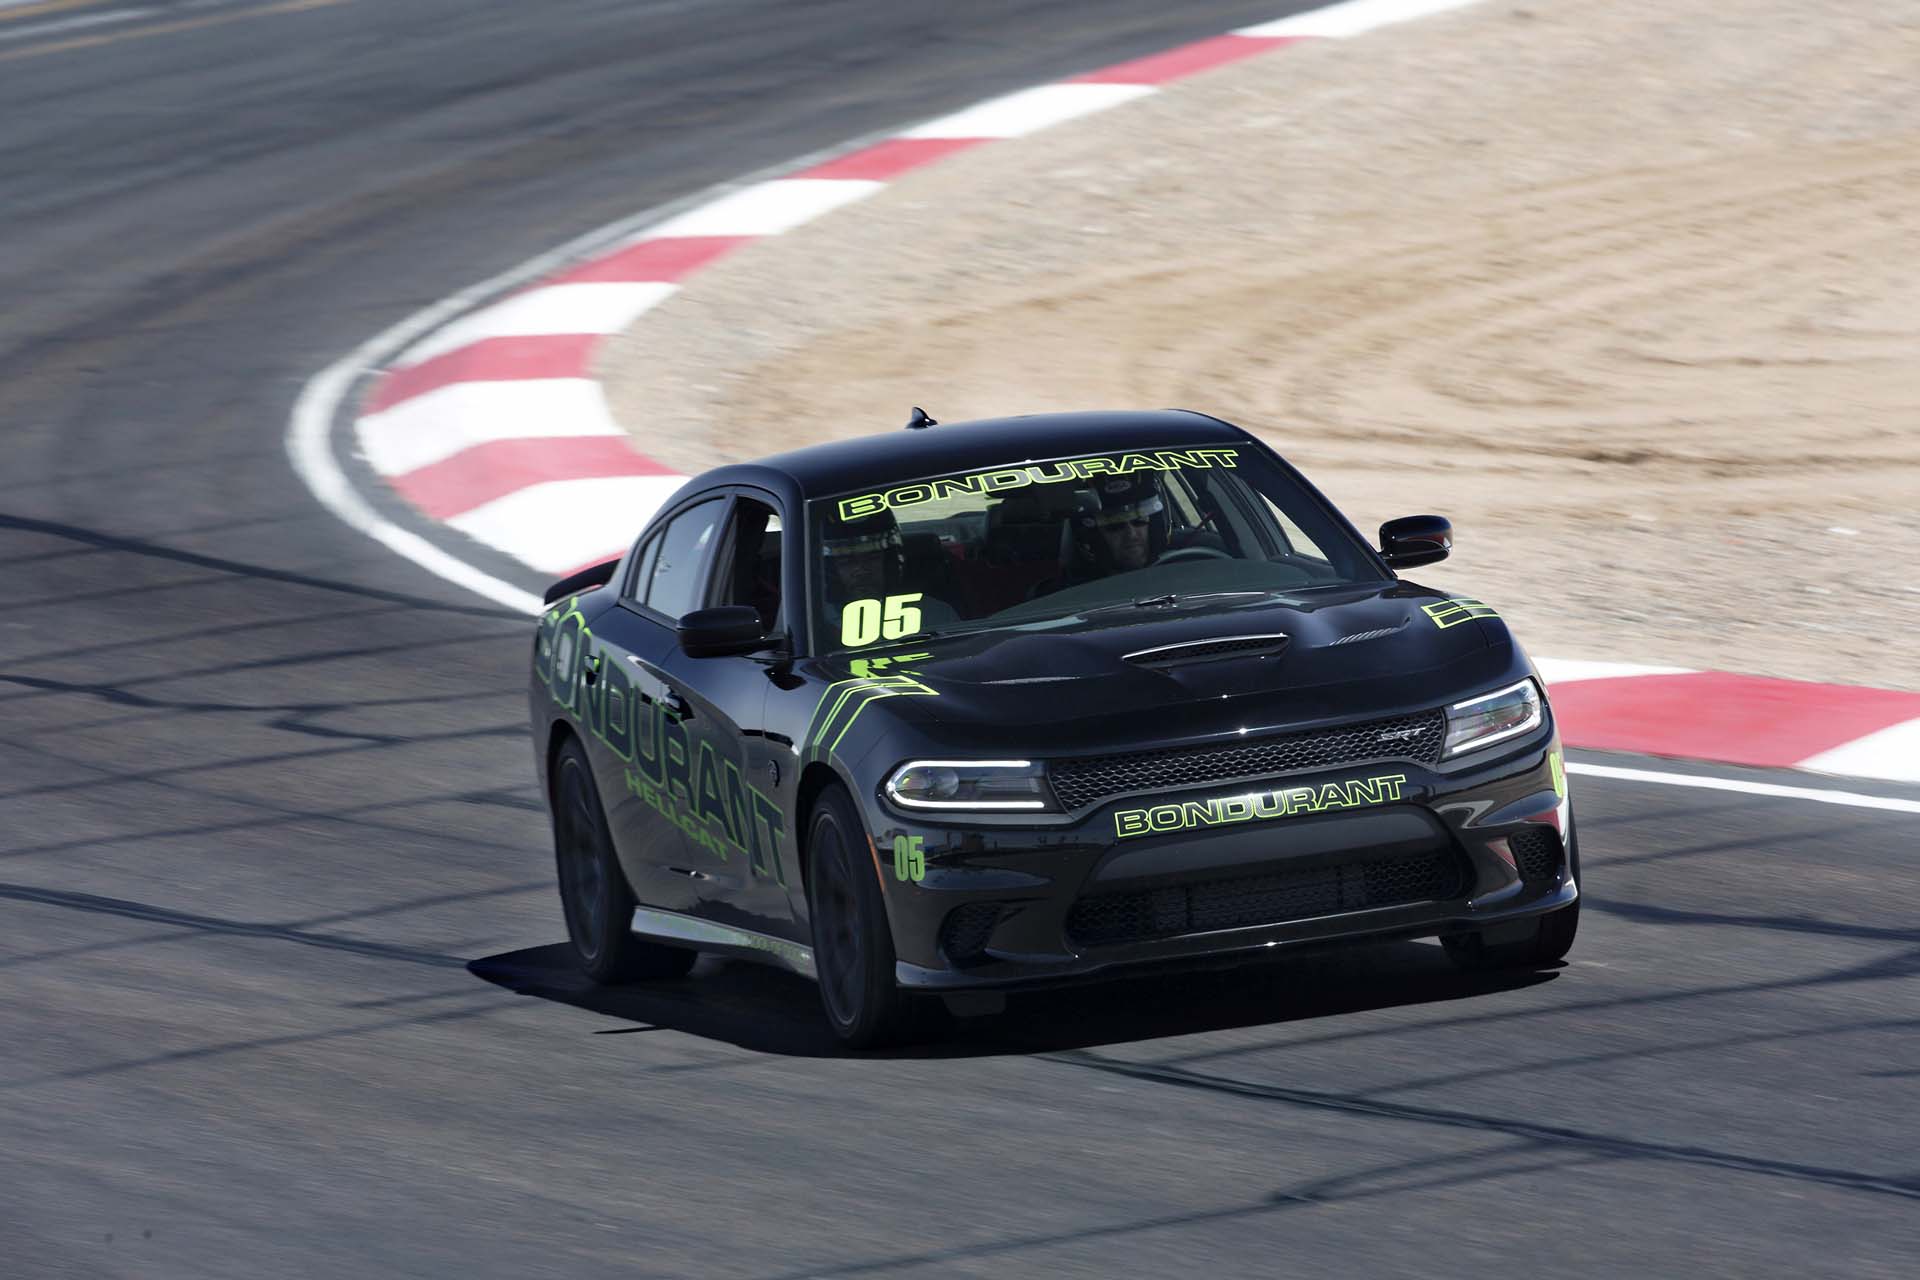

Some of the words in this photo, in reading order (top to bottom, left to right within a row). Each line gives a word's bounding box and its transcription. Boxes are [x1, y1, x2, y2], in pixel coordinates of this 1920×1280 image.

[838, 449, 1239, 521] BONDURANT
[841, 593, 923, 647] 05
[535, 597, 786, 890] BONDURANT
[1377, 727, 1426, 742] SRT
[624, 766, 729, 862] HELLCAT
[1115, 774, 1406, 837] BONDURANT
[894, 835, 925, 881] 05
